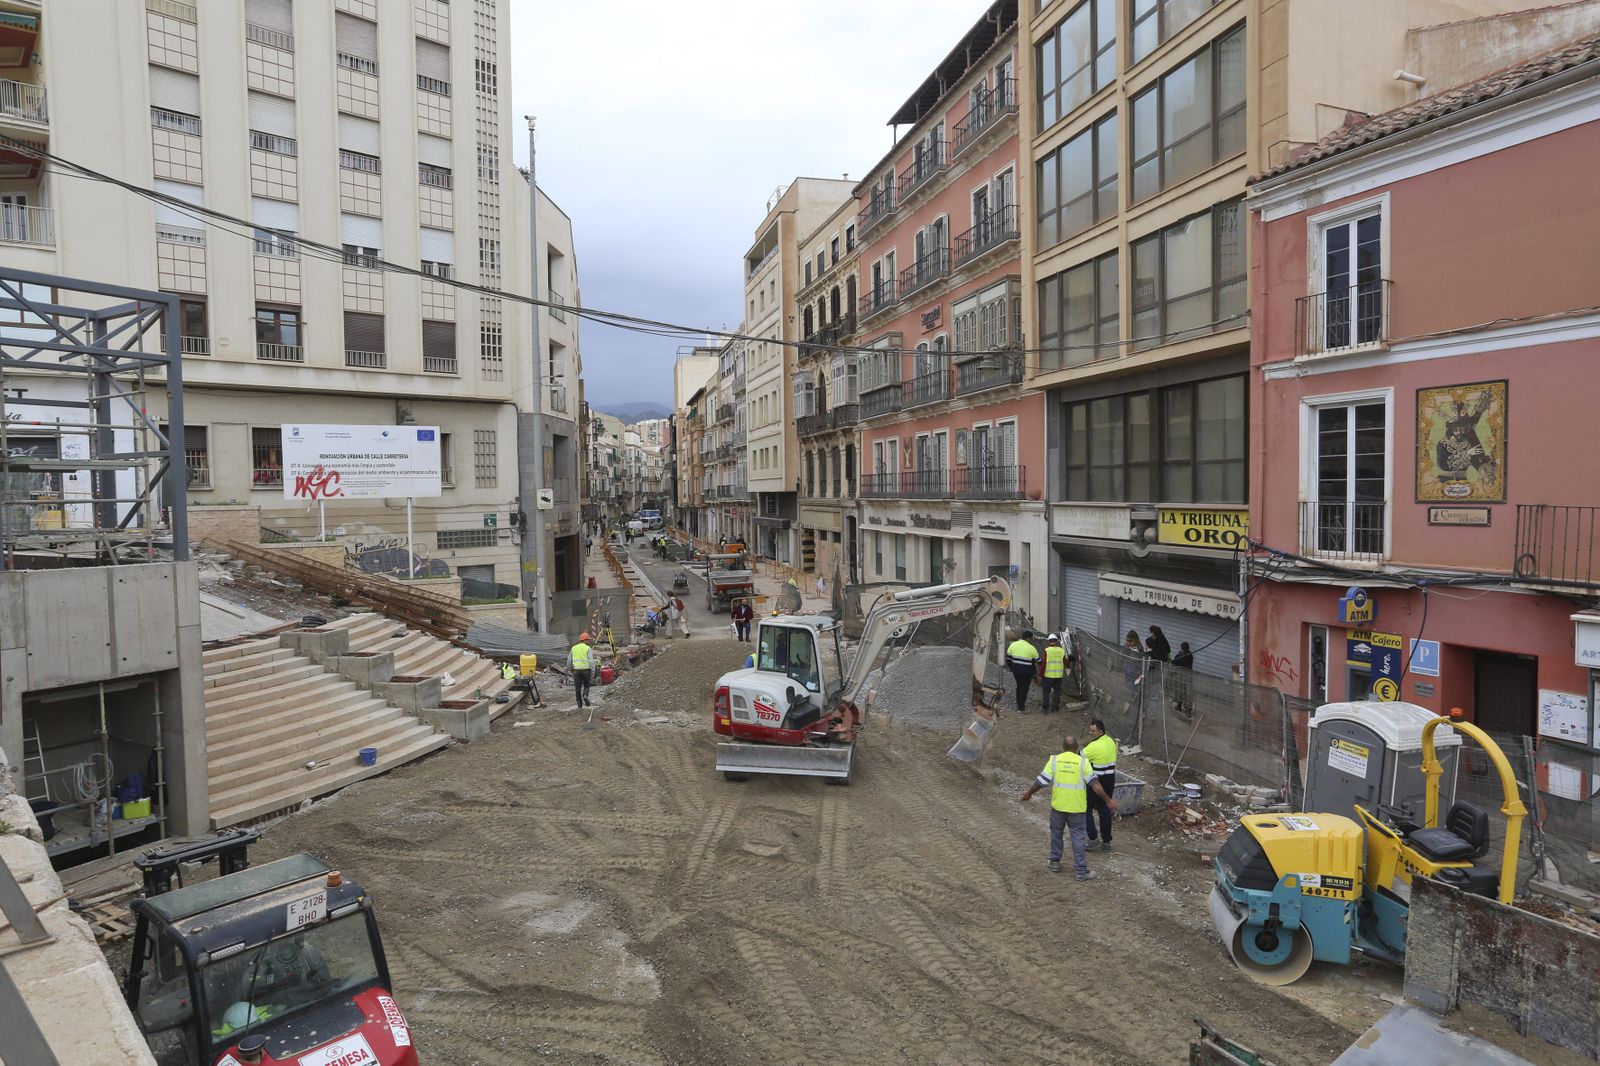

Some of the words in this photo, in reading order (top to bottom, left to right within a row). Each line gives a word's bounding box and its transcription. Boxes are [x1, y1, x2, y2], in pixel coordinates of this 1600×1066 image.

[1161, 511, 1177, 525] LA
[1180, 512, 1242, 528] TRIBUNA
[1184, 527, 1241, 546] ORO
[1123, 587, 1133, 596] LA
[1144, 590, 1178, 604] TRIBUNA
[1191, 598, 1202, 608] DE
[1216, 603, 1236, 614] ORO
[1350, 610, 1369, 621] ATM
[1372, 635, 1401, 647] Cajero
[1420, 646, 1430, 663] P
[756, 711, 781, 722] TB370
[290, 904, 296, 915] E
[302, 894, 324, 911] 2128
